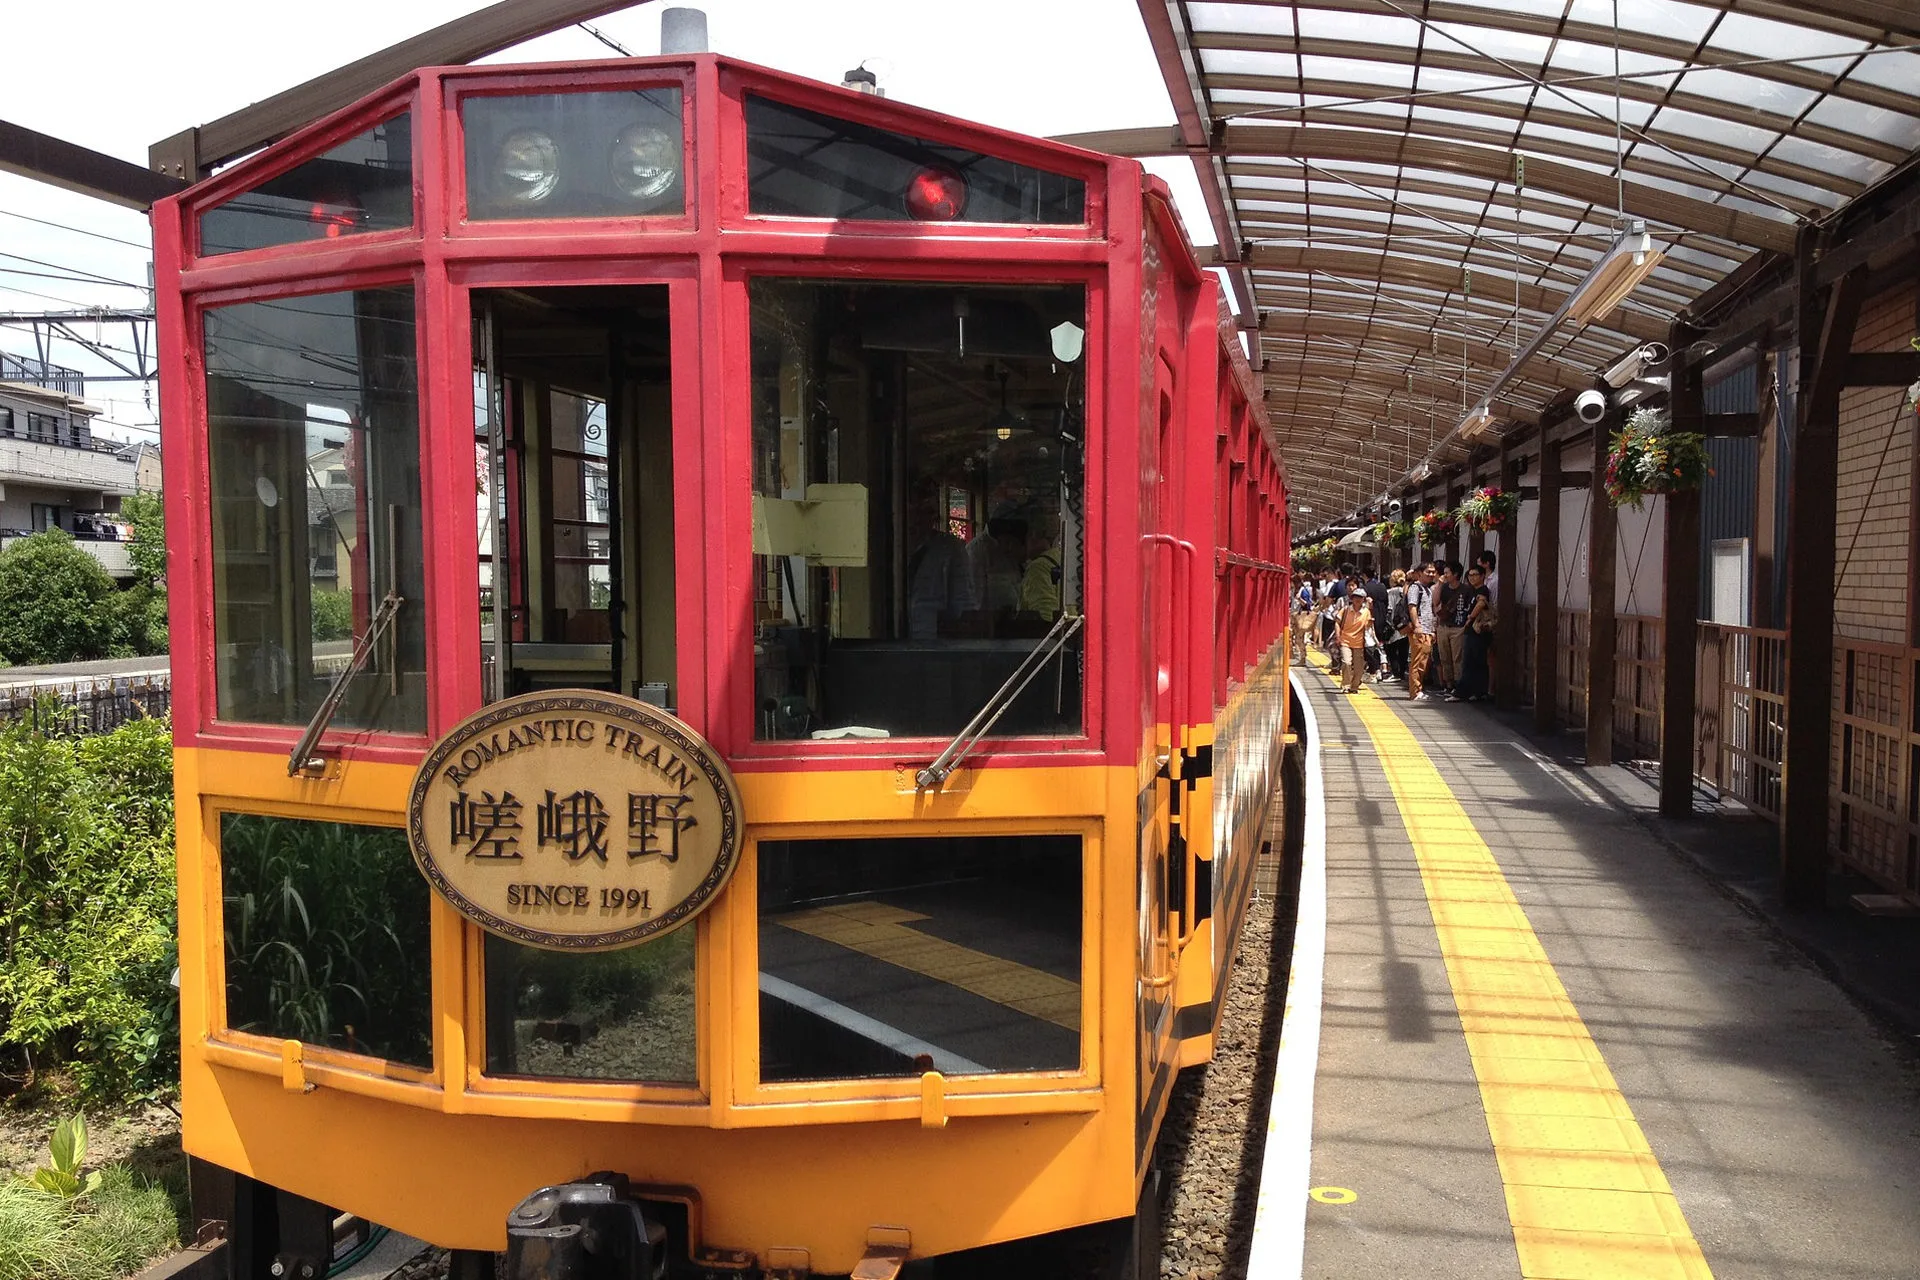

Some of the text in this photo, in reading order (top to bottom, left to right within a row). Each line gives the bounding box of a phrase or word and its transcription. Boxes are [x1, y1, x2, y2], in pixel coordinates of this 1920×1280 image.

[443, 719, 699, 791] ROMANTIC TRAIN
[449, 789, 698, 863] 嵯峨野
[507, 883, 652, 911] SINCE 1991
